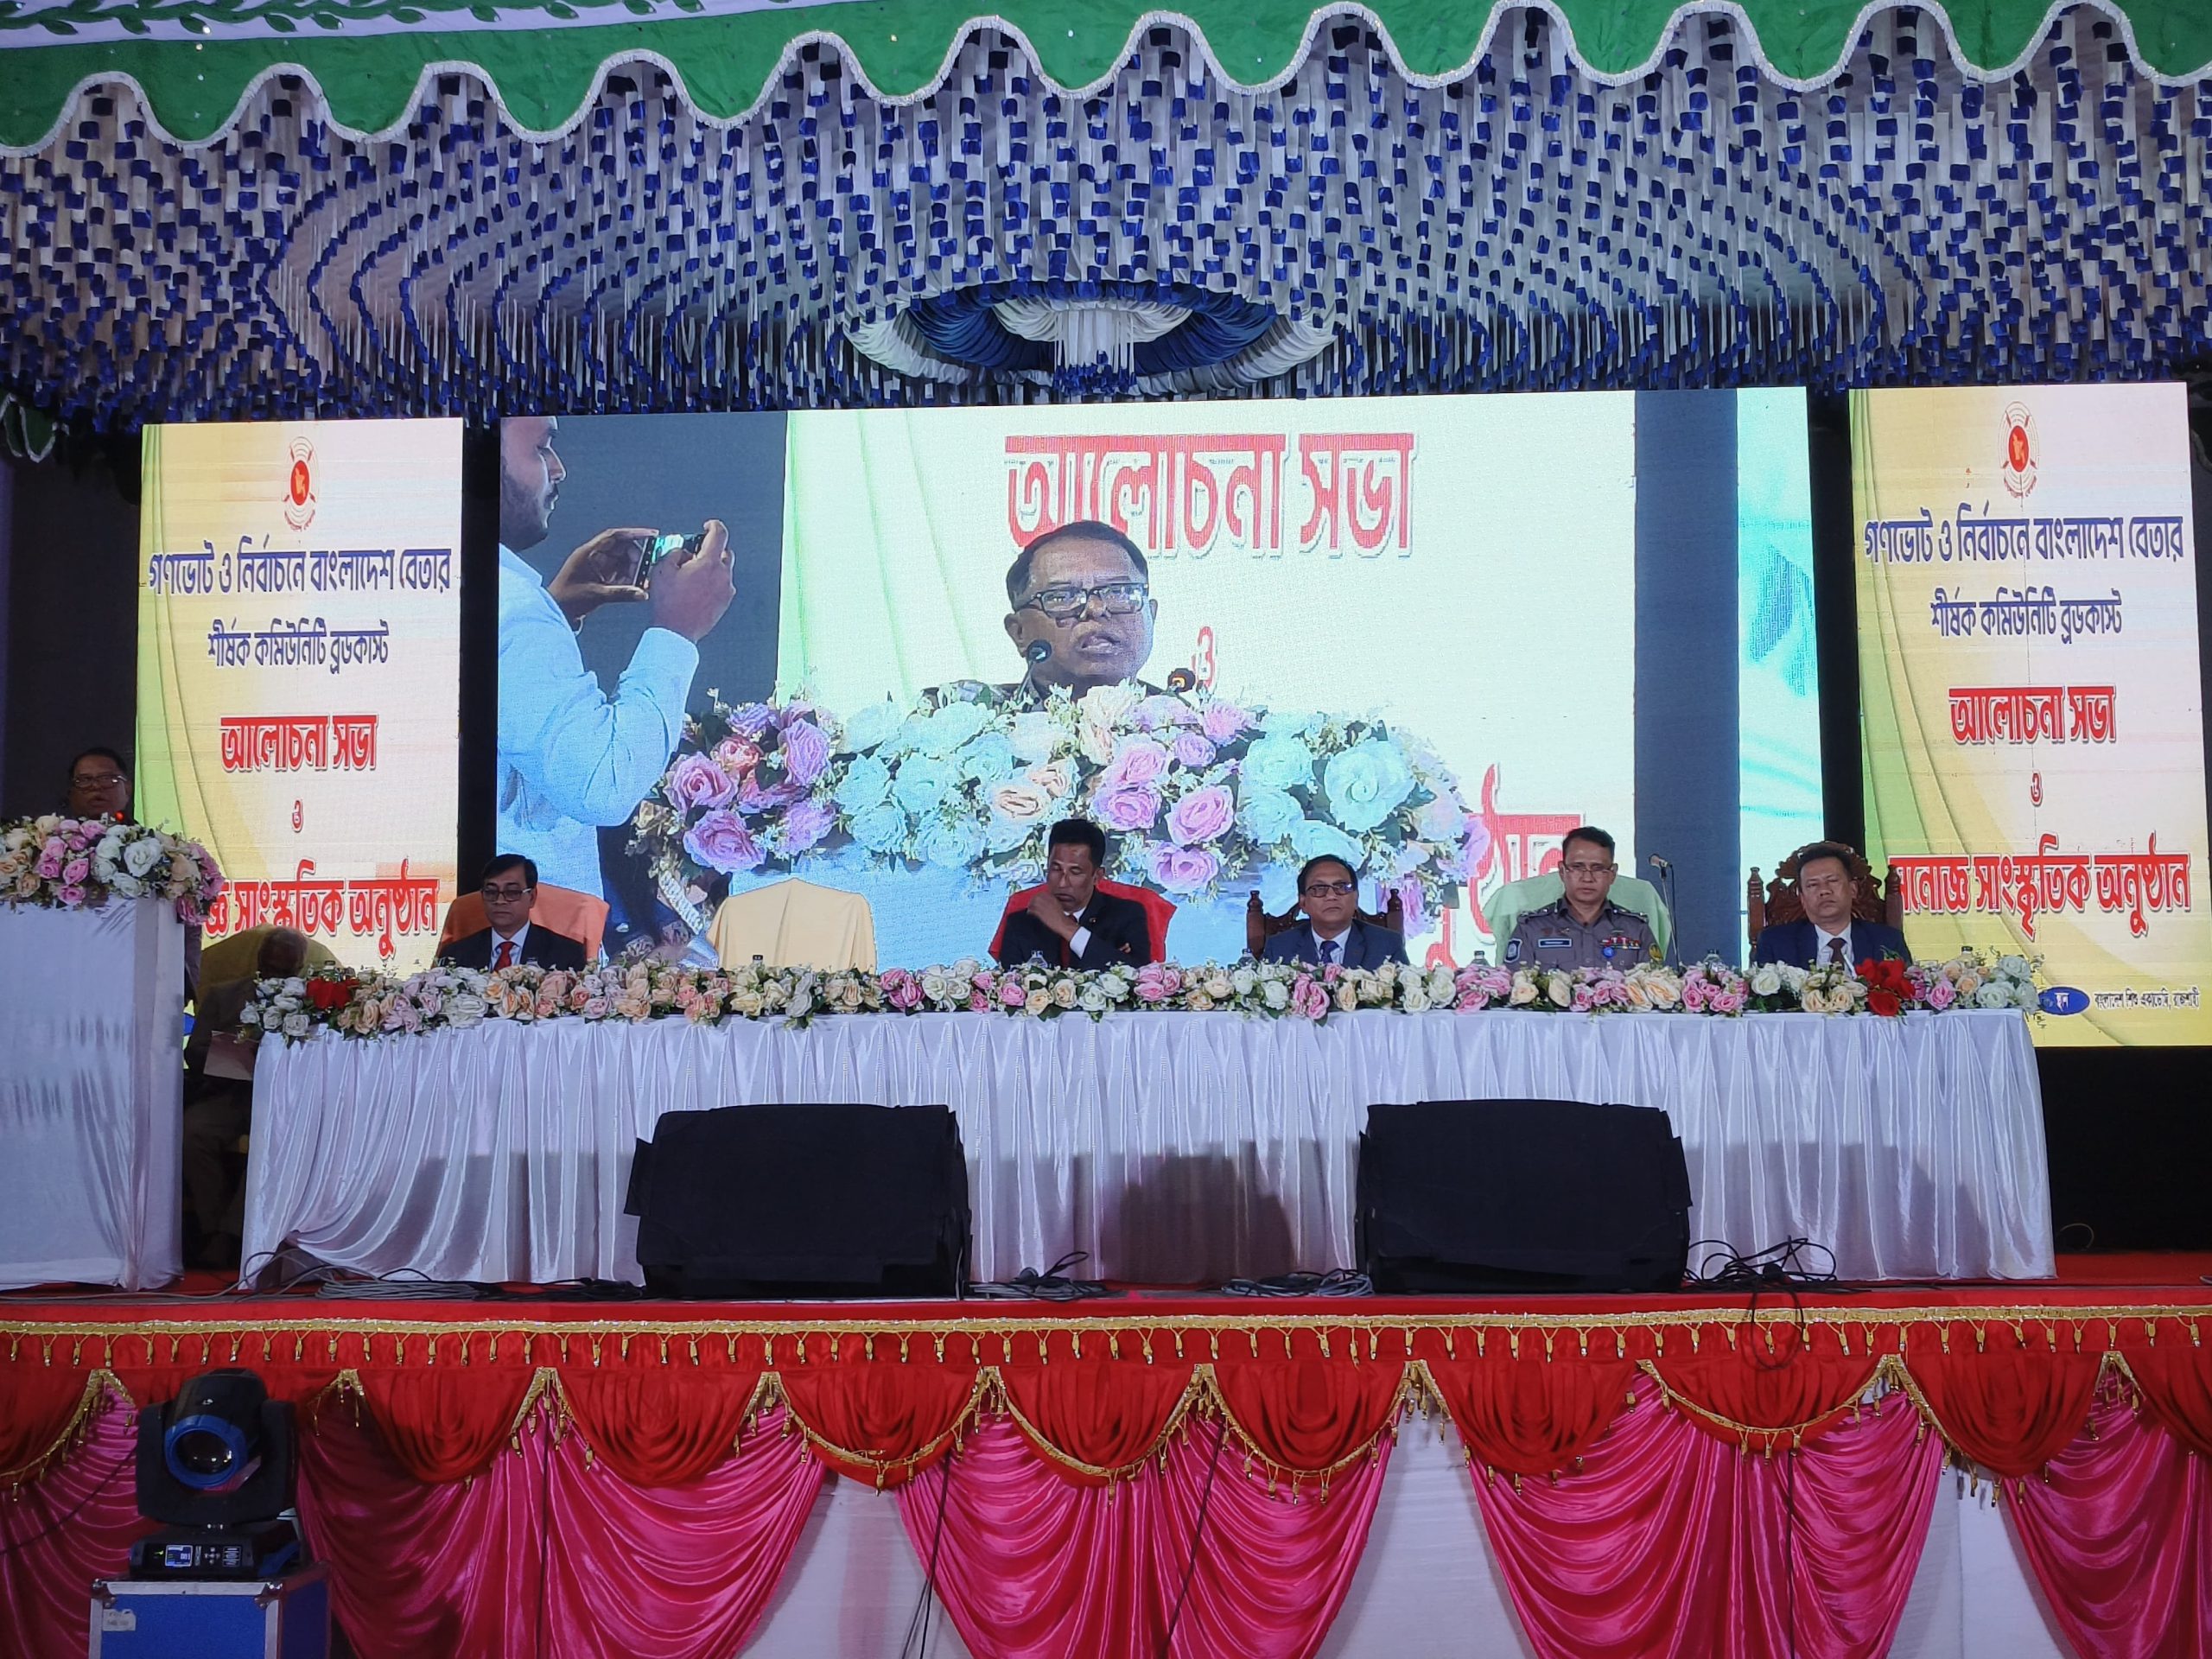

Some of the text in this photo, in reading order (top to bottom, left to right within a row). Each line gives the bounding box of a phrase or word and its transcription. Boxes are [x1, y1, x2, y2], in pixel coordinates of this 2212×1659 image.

[1005, 434, 1414, 550] আলোচনা সভা
[1865, 502, 2183, 563] গণভোট ও নির্বাচনে বাংলাদেশ বেতার
[149, 536, 452, 594] গণভোট ও নির্বাচনে বাংলাদেশ বেতার
[1930, 588, 1977, 636] শীর্ষক
[1979, 586, 2057, 635] কমিউনিটি
[208, 620, 251, 664] শীর্ষক
[253, 616, 327, 664] কমিউনিটি
[1948, 686, 2115, 741] আলোচনা সভা
[220, 715, 378, 770] আলোচনা সভা
[292, 800, 303, 830] ও
[2031, 772, 2043, 804] ও
[347, 860, 440, 957] অনুষ্ঠান
[2094, 836, 2190, 934] অনুষ্ঠান
